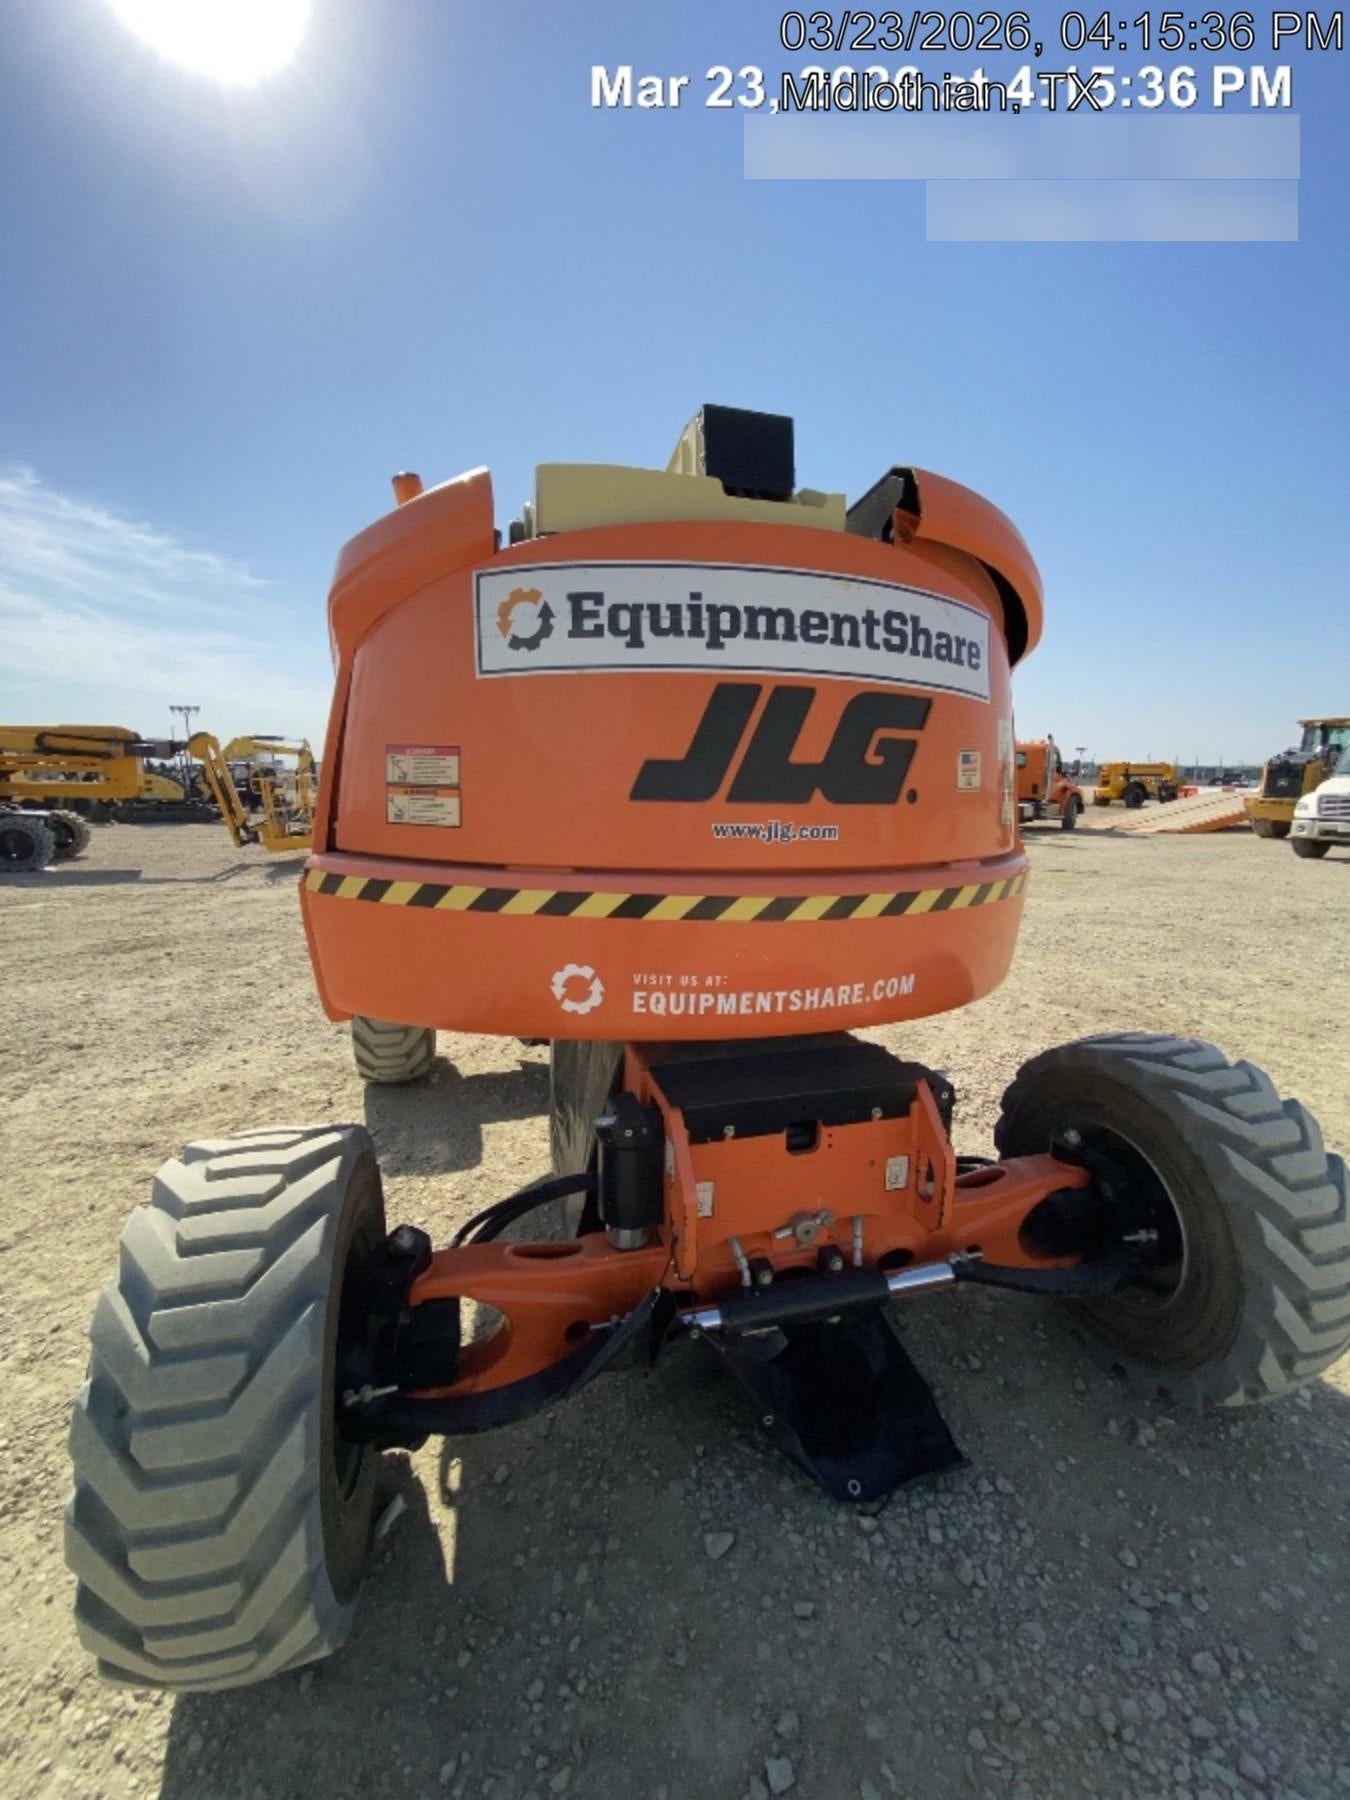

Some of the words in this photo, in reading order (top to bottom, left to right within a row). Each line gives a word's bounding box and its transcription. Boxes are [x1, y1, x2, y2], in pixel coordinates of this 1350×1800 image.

[567, 592, 982, 671] EquipmentShare
[711, 820, 839, 842] www.jlg.com
[632, 973, 916, 1016] EQUIPMENTSHARE.COM
[633, 973, 673, 985] VISIT
[680, 975, 699, 987] US
[705, 976, 728, 987] AT:
